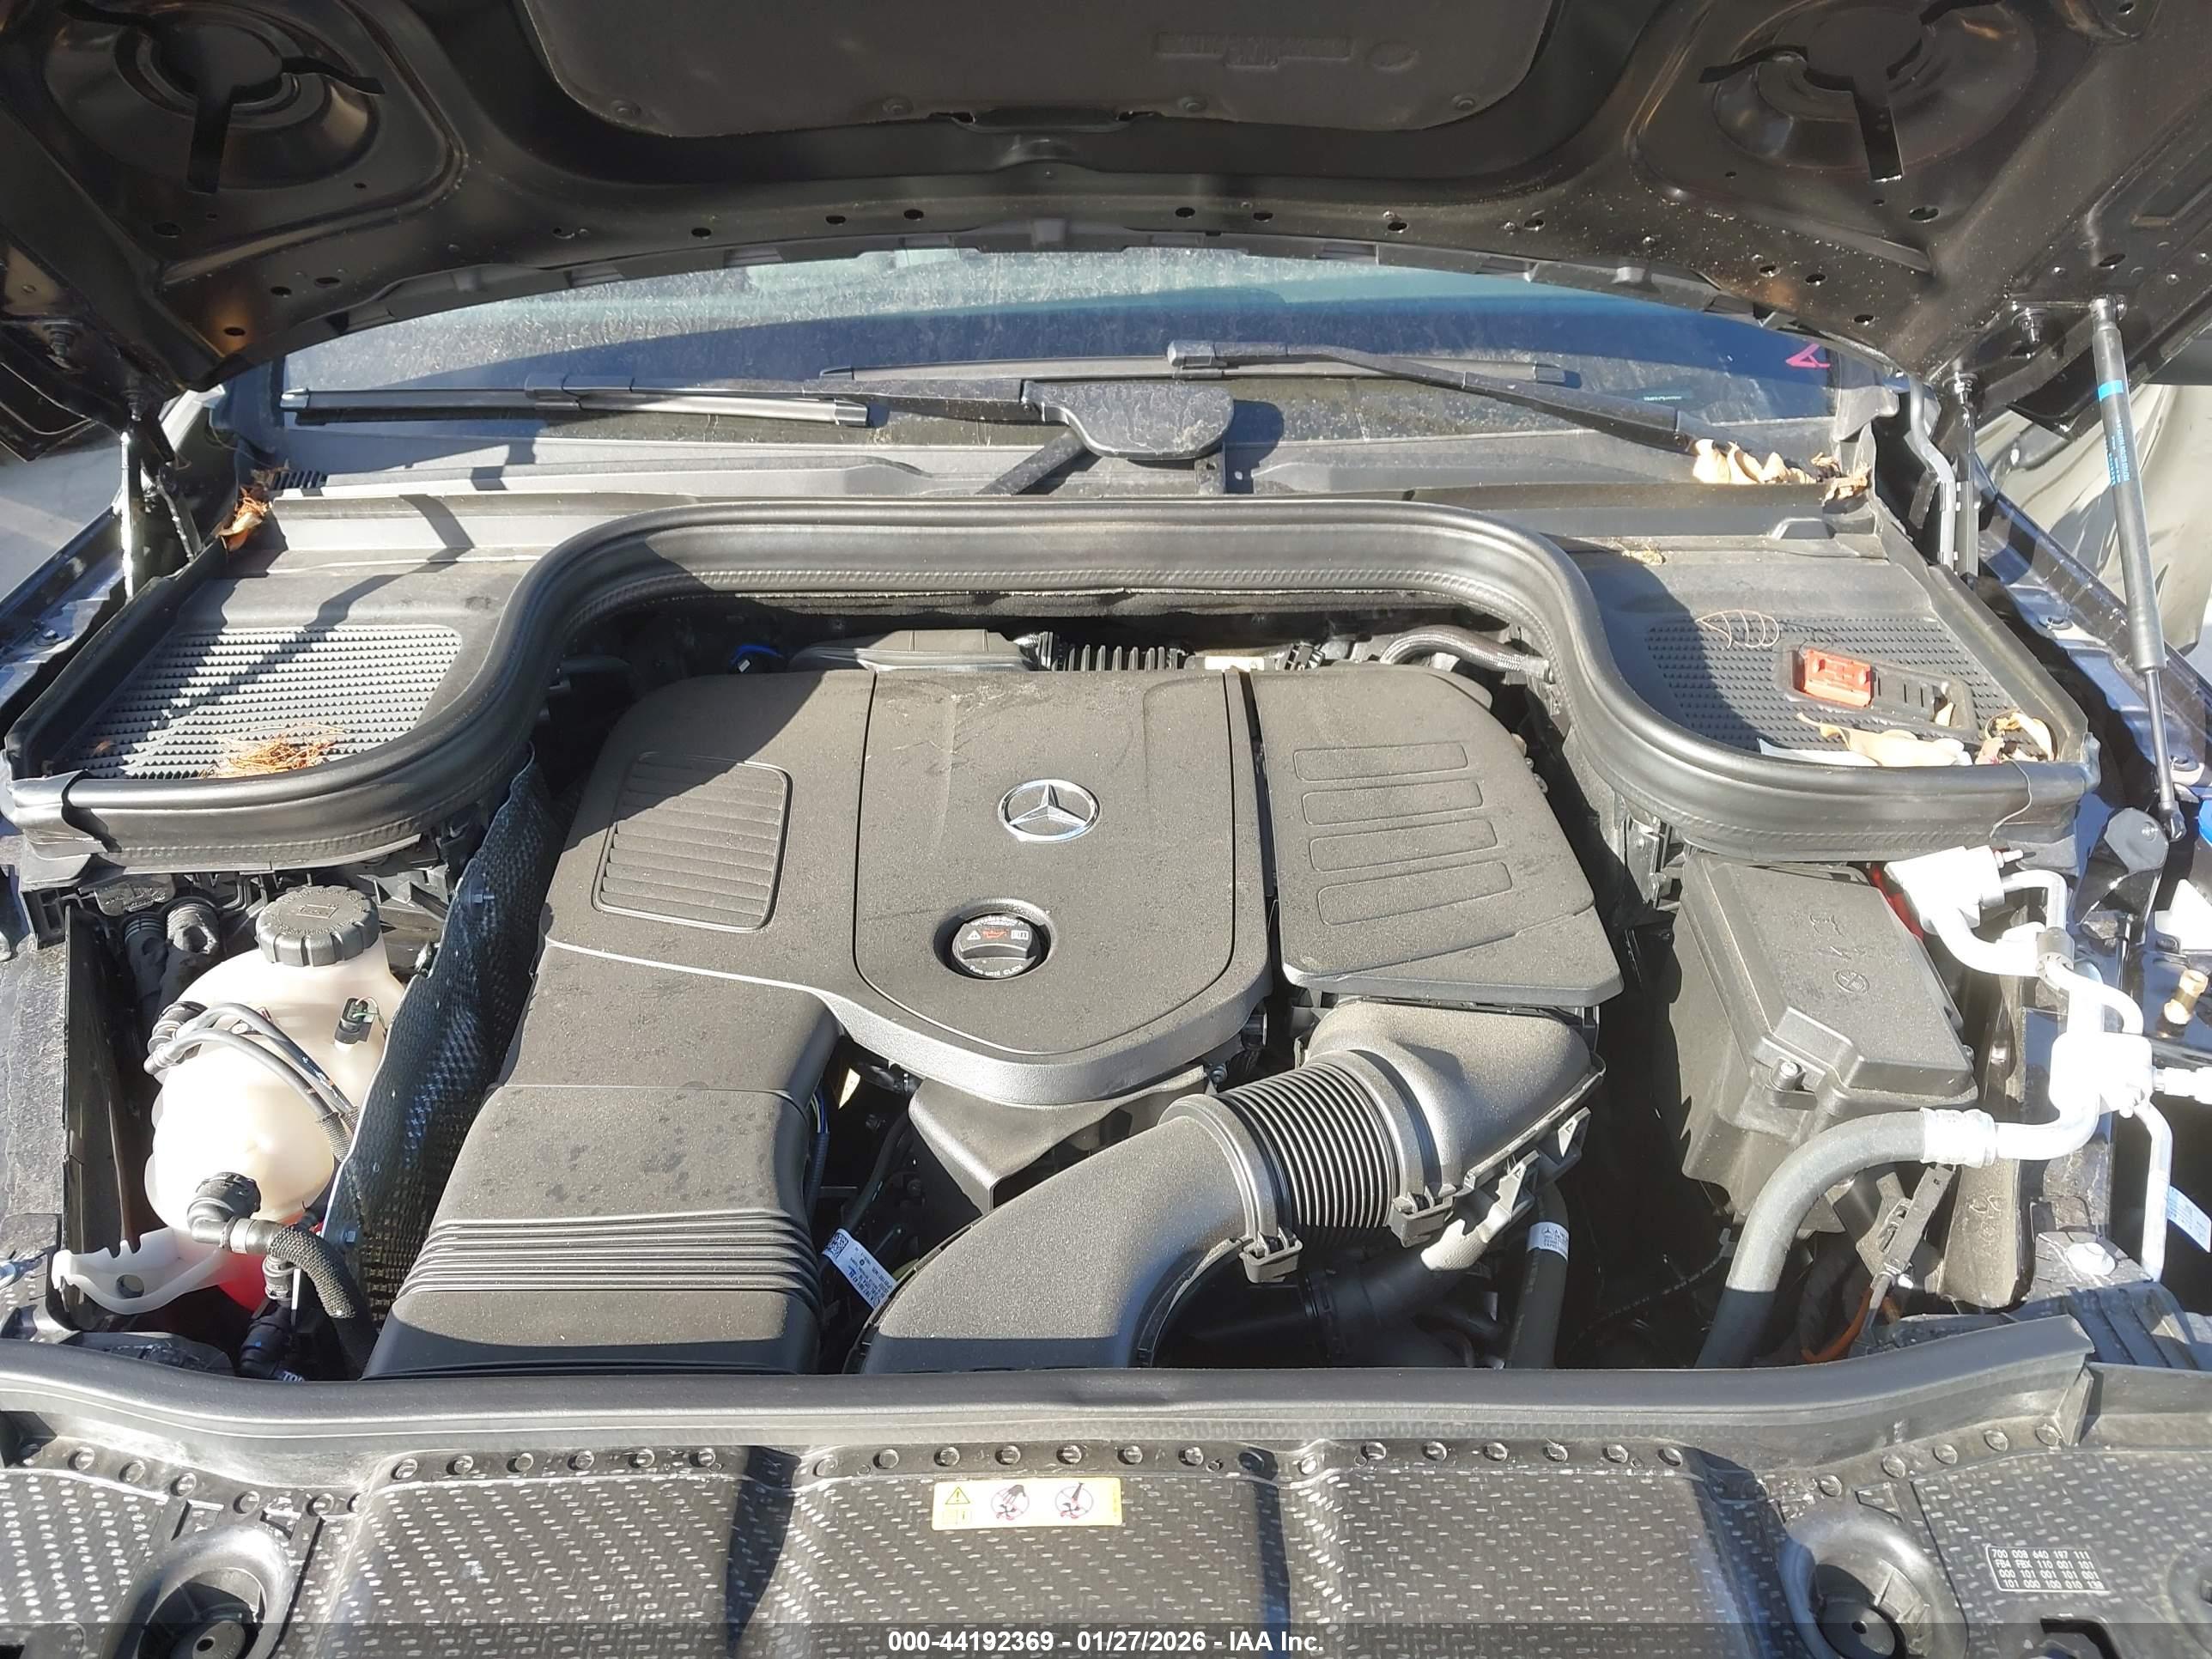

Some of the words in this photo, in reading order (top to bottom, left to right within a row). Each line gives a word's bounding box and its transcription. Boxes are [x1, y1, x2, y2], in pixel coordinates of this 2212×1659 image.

[1003, 963, 1024, 976] CLICK
[1991, 1548, 2008, 1559] 700
[2032, 1550, 2049, 1559] 640
[2053, 1550, 2068, 1559] 197
[2073, 1551, 2090, 1560] 111
[2037, 1560, 2053, 1570] 110
[2057, 1560, 2074, 1570] 001
[2078, 1560, 2094, 1570] 101
[1998, 1569, 2016, 1578] 000
[2020, 1570, 2036, 1579] 101
[2040, 1570, 2057, 1579] 001
[2062, 1571, 2078, 1579] 101
[2081, 1571, 2100, 1580] 001
[2003, 1579, 2020, 1589] 101
[2023, 1579, 2041, 1589] 000
[2045, 1580, 2062, 1589] 100
[2065, 1580, 2083, 1589] 010
